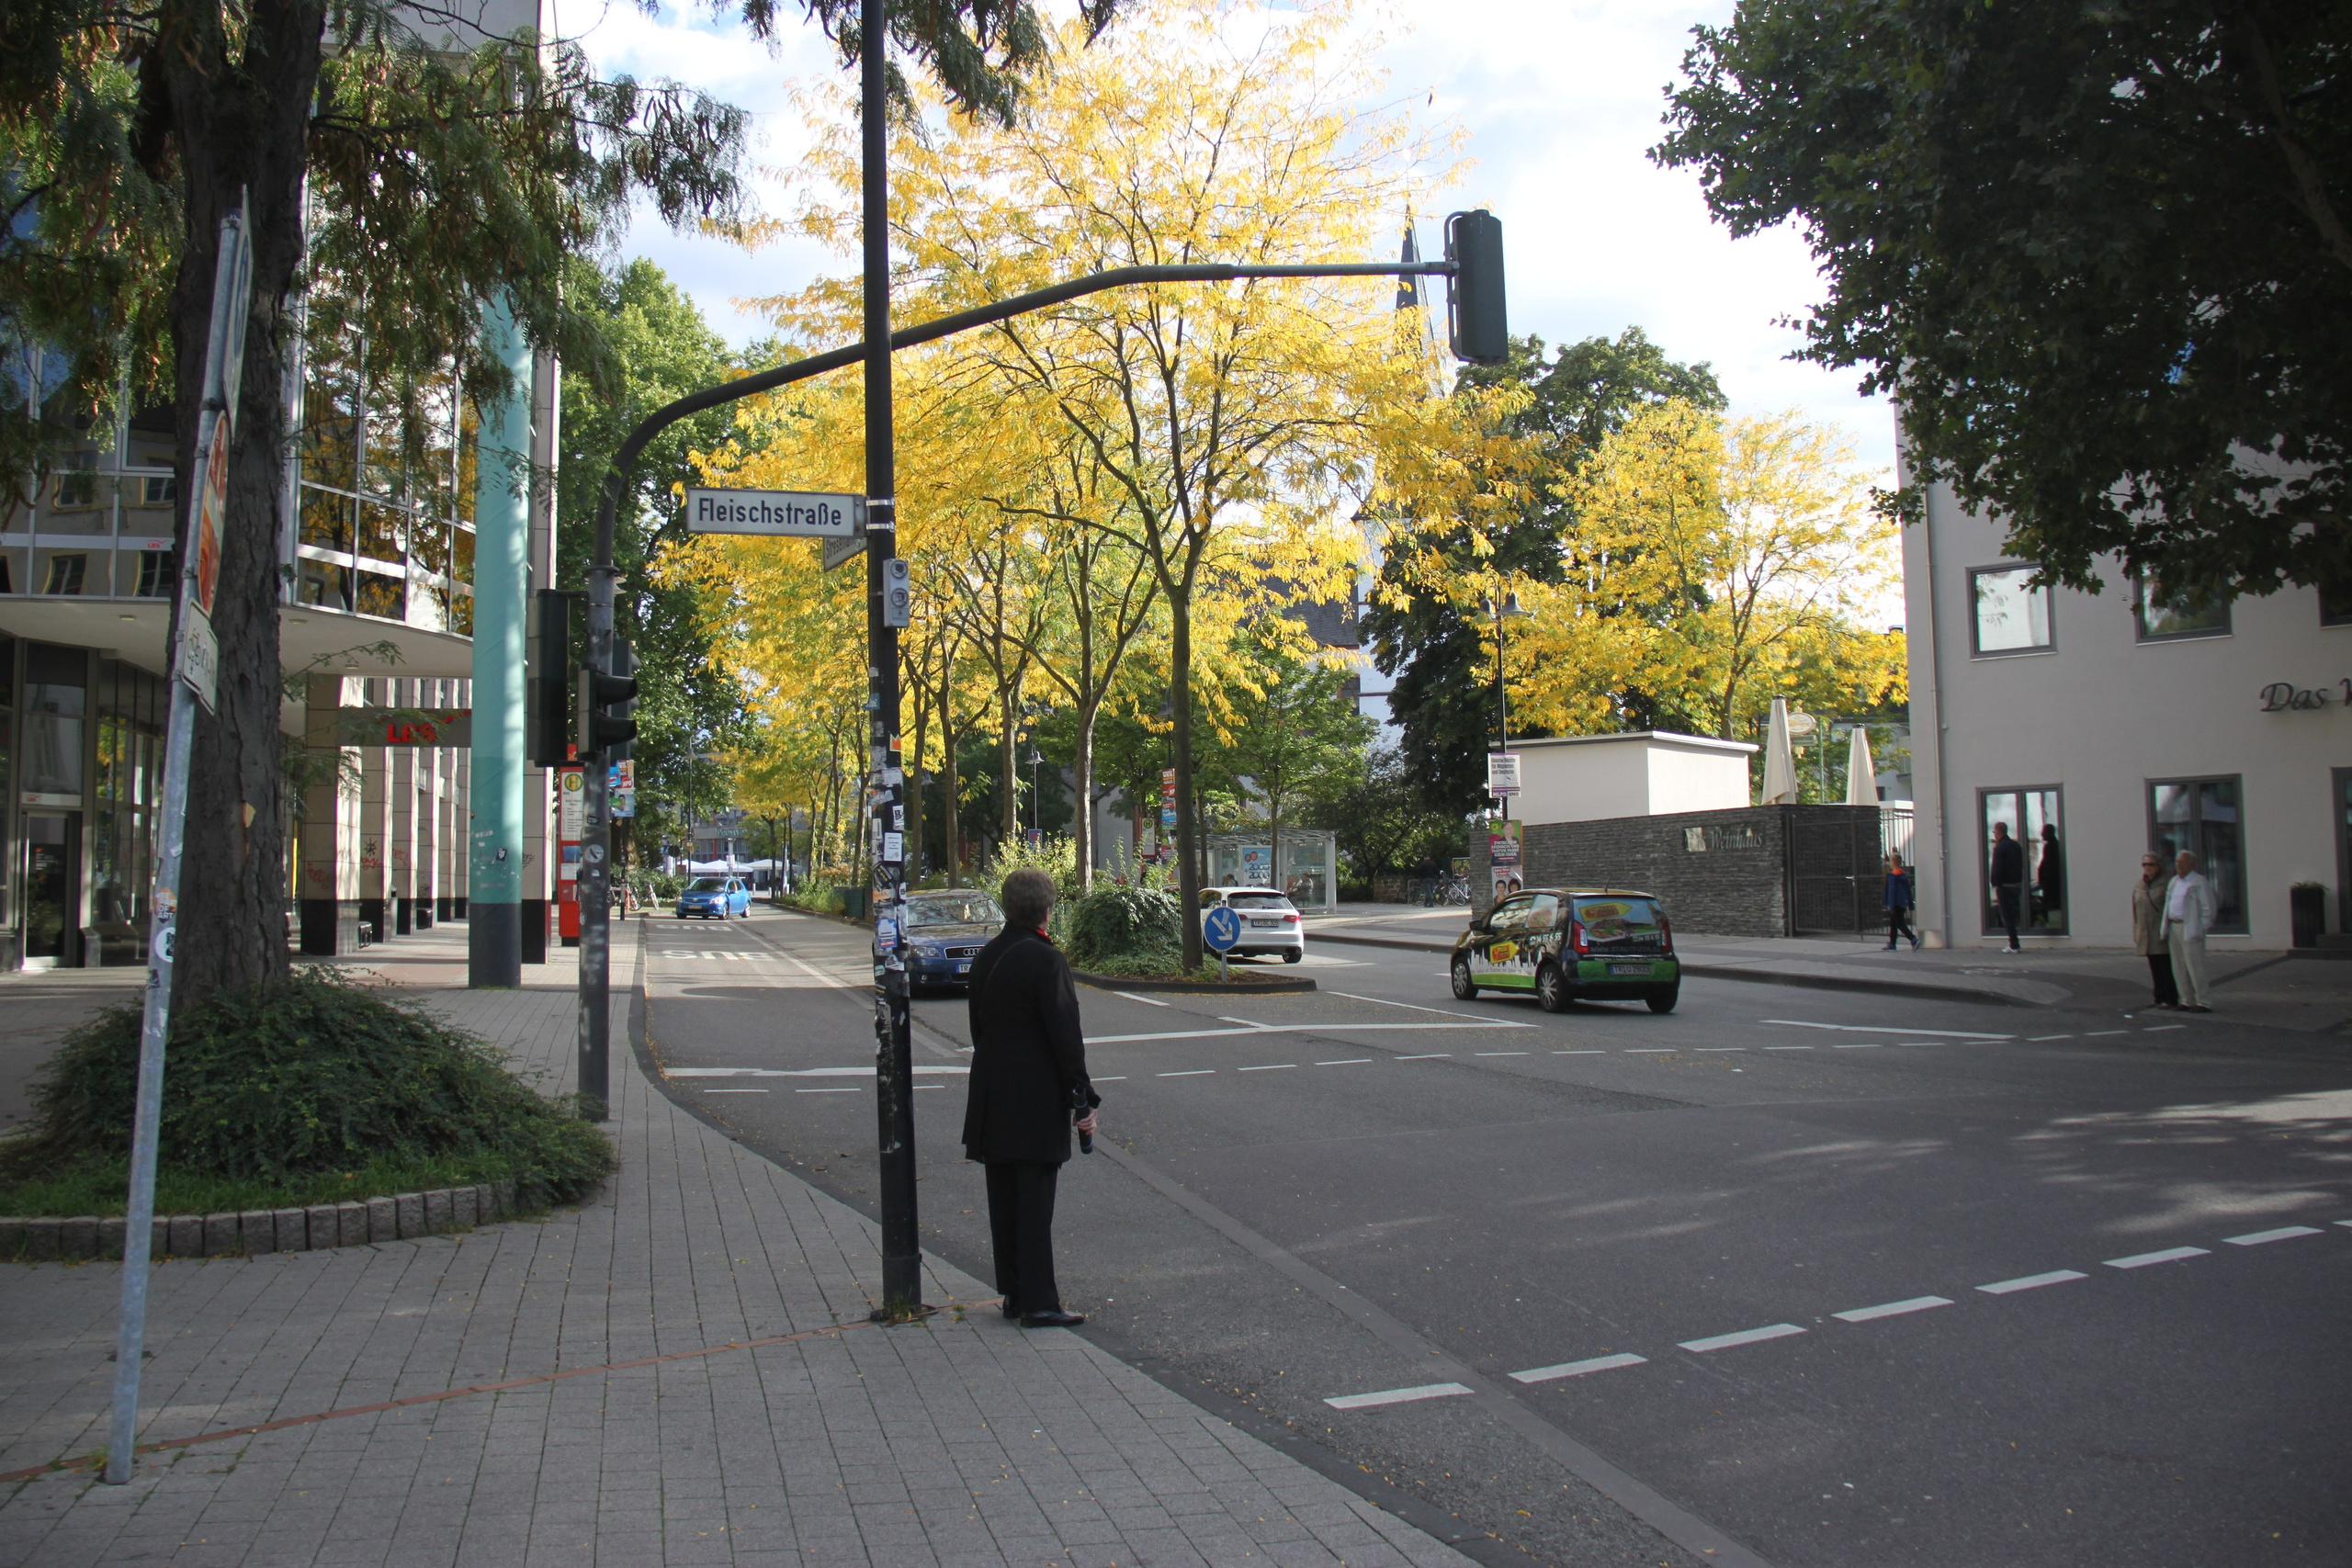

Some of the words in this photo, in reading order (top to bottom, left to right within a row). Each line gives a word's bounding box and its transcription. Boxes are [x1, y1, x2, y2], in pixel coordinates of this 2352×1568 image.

[698, 497, 842, 525] Fleischstraße
[2259, 682, 2328, 712] Das
[387, 723, 437, 743] LBS
[1711, 824, 1763, 850] Weinhaus
[662, 949, 777, 962] BUS
